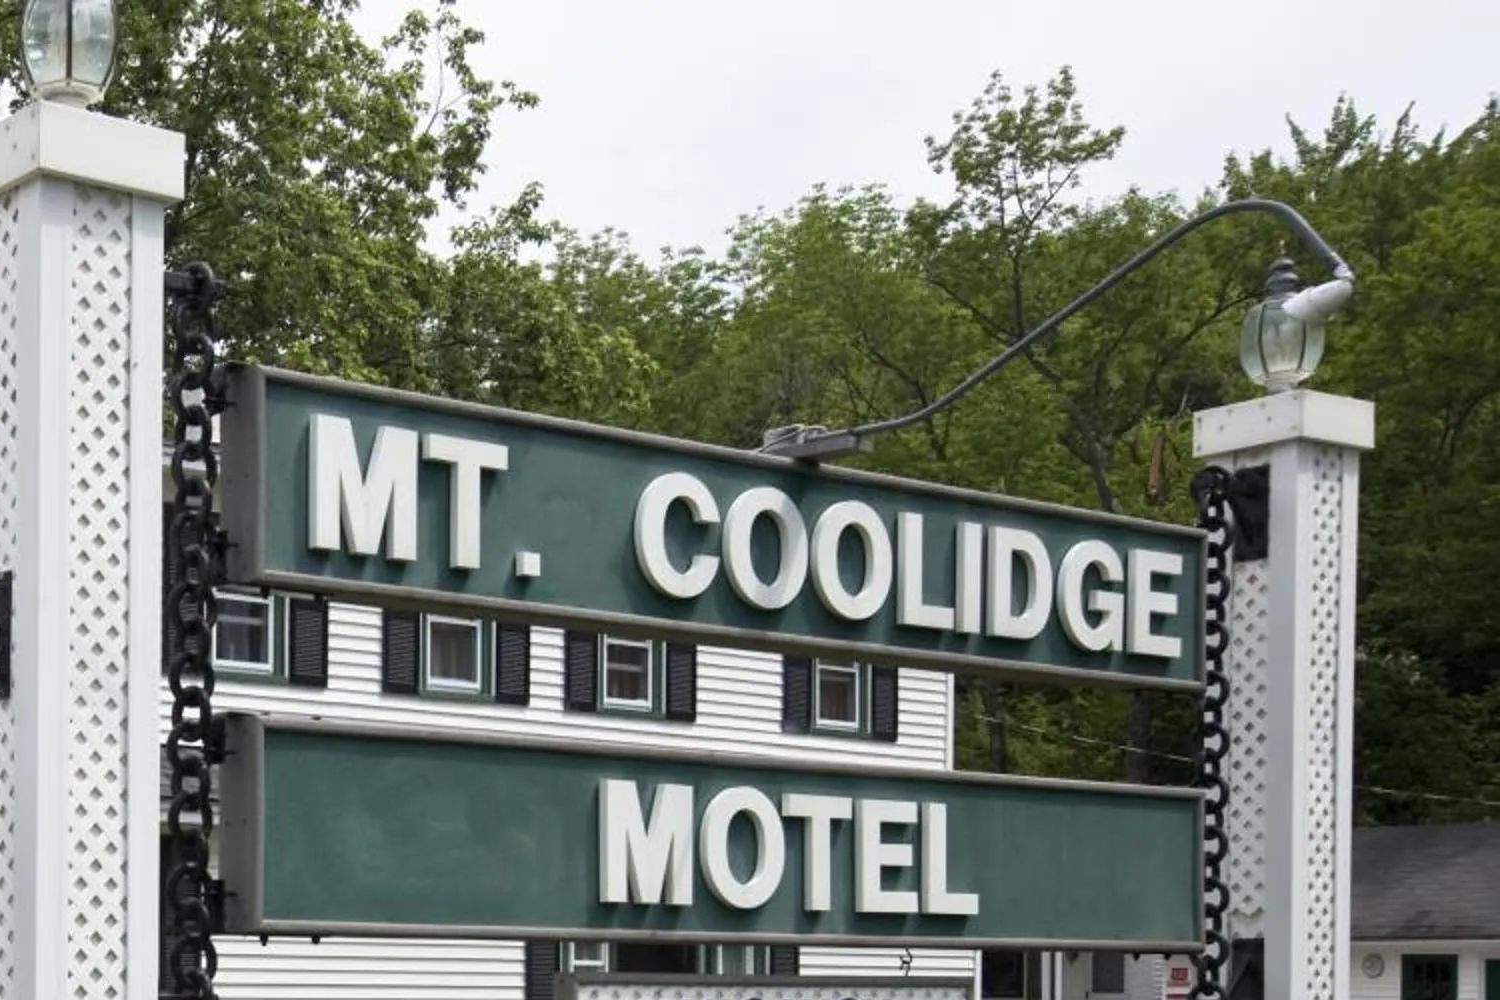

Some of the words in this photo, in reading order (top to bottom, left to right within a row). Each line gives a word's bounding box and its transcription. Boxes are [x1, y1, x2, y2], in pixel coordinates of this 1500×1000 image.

[308, 413, 541, 578] MT.
[634, 471, 1183, 658] COOLIDGE
[598, 778, 979, 915] MOTEL
